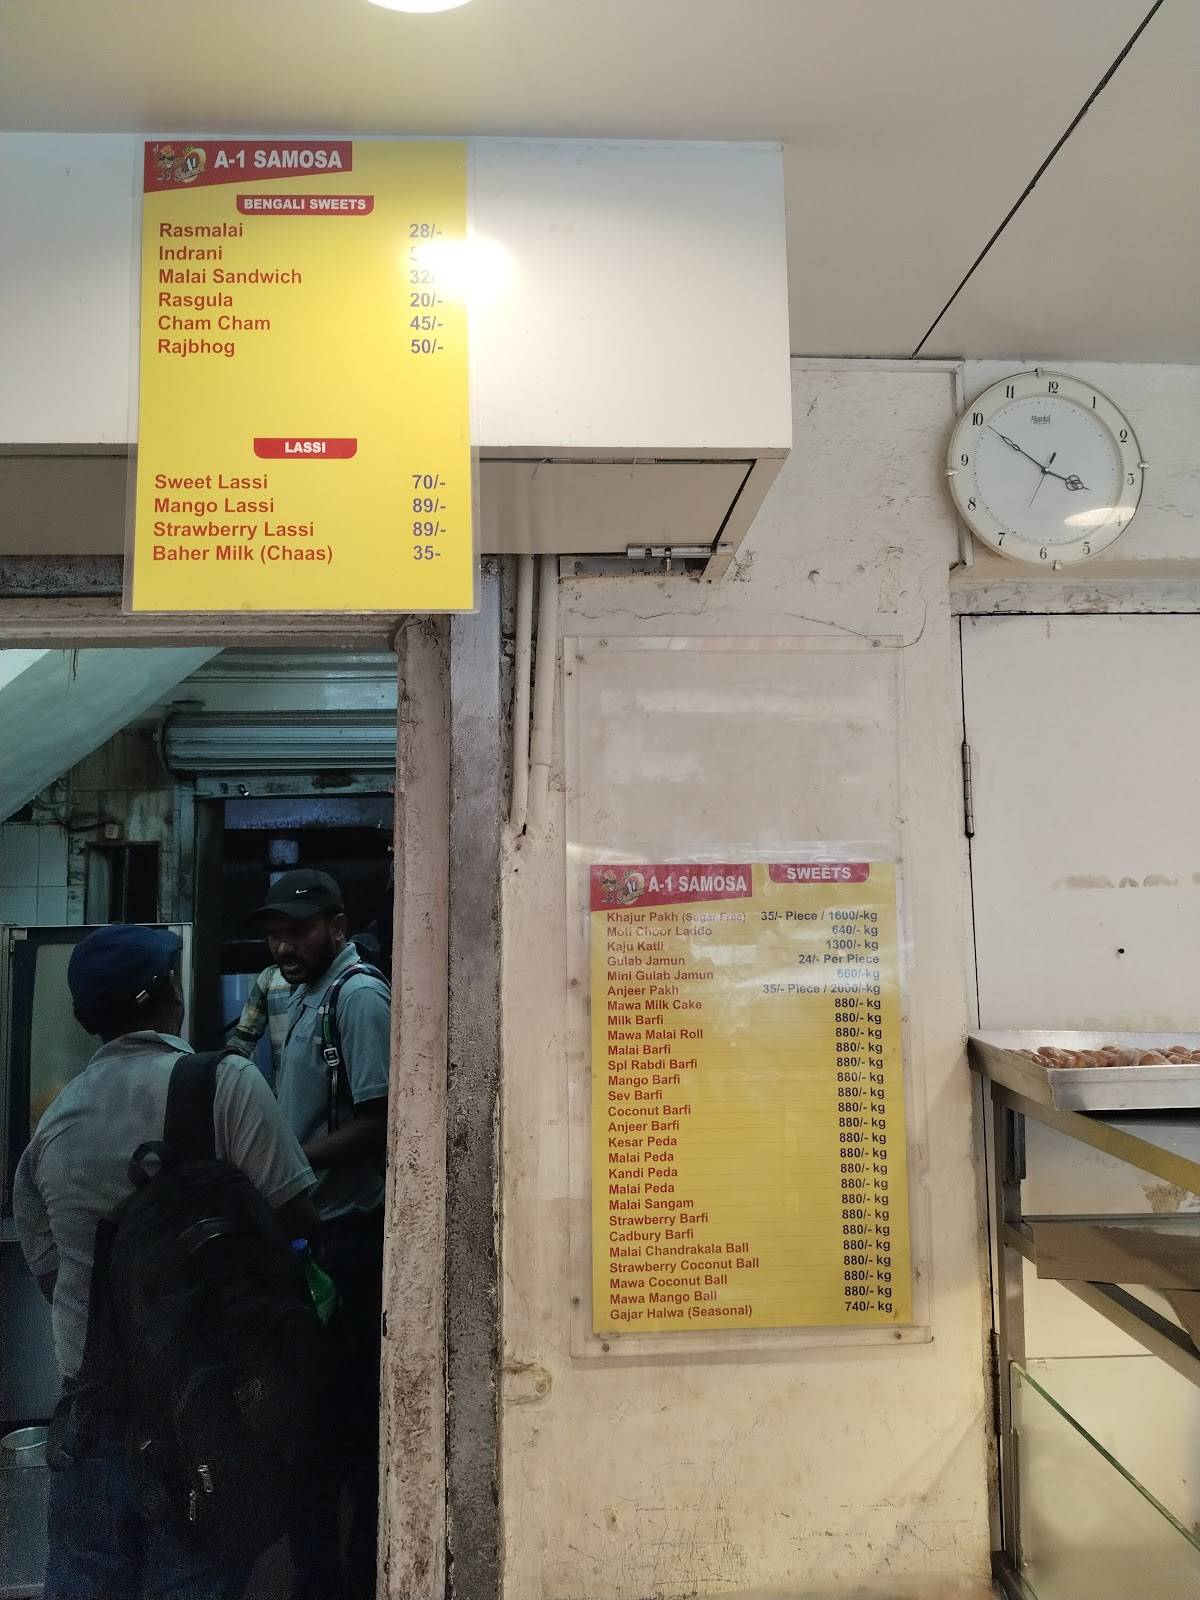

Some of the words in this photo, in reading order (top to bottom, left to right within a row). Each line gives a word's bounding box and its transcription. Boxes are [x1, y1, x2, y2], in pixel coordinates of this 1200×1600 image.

[214, 152, 245, 168] A-1
[254, 151, 342, 168] SAMOSA
[245, 199, 304, 209] BENGALI
[310, 199, 366, 210] SWEETS
[160, 223, 242, 237] Rasmalai
[409, 224, 442, 238] 28/-
[160, 246, 222, 260] Indrani
[160, 269, 205, 283] Malai
[213, 269, 301, 283] Sandwich
[159, 292, 232, 310] Rasgula
[410, 293, 442, 307] 20/-
[159, 316, 210, 330] Cham
[218, 316, 270, 330] Cham
[410, 316, 442, 330] 45/-
[159, 339, 234, 357] Rajbhog
[411, 339, 443, 353] 50/-
[1007, 385, 1014, 398] 11
[1049, 382, 1058, 393] 12
[973, 413, 983, 425] 10
[1120, 430, 1127, 442] 2
[285, 442, 325, 453] LASSI
[962, 455, 968, 465] 9
[155, 474, 211, 489] Sweet
[219, 475, 267, 489] Lassi
[413, 475, 445, 489] 70/-
[155, 498, 217, 516] Mango
[225, 498, 273, 512] Lassi
[413, 498, 445, 512] 89/-
[968, 497, 976, 510] 8
[154, 522, 257, 540] Strawberry
[265, 522, 313, 536] Lassi
[413, 522, 446, 536] 89/-
[999, 533, 1005, 546] 7
[154, 546, 209, 560] Baher
[216, 546, 253, 560] Milk
[261, 545, 332, 564] (Chaas)
[414, 546, 440, 560] 35-
[1040, 548, 1047, 559] 6
[1084, 542, 1090, 554] 5
[787, 868, 851, 879] SWEETS
[649, 878, 672, 891] A-1
[679, 876, 747, 892] SAMOSA
[608, 912, 646, 924] Khajur
[650, 912, 678, 921] Pakh
[761, 912, 782, 920] 35/-
[786, 911, 817, 920] Piece
[829, 911, 877, 922] 1600/-kg
[832, 925, 860, 934] 640/-
[864, 925, 878, 936] kg
[608, 942, 633, 953] Kaju
[638, 942, 663, 951] Katli
[827, 940, 861, 949] 1300/-
[865, 940, 878, 951] kg
[608, 956, 642, 966] Gulab
[646, 956, 685, 965] Jamun
[799, 954, 819, 963] 24/-
[824, 954, 843, 963] Per
[847, 954, 879, 963] Piece
[607, 970, 634, 981] Mini
[637, 971, 670, 980] Gulab
[674, 971, 713, 980] Jamun
[608, 986, 645, 997] Anjeer
[650, 985, 678, 995] Pakh
[608, 1001, 641, 1010] Mawa
[646, 1000, 668, 1009] Milk
[673, 1000, 701, 1009] Cake
[834, 998, 863, 1008] 880/-
[867, 998, 880, 1009] kg
[608, 1016, 631, 1025] Milk
[636, 1015, 663, 1024] Barfi
[835, 1013, 864, 1023] 880/-
[868, 1013, 881, 1024] kg
[608, 1031, 641, 1040] Mawa
[646, 1030, 675, 1039] Malai
[681, 1029, 702, 1039] Roll
[836, 1027, 864, 1038] 880/-
[868, 1028, 881, 1039] kg
[609, 1046, 638, 1055] Malai
[644, 1045, 670, 1054] Barfi
[836, 1042, 865, 1052] 880/-
[869, 1042, 882, 1054] kg
[609, 1060, 626, 1072] Spl
[632, 1060, 665, 1069] Rabdi
[670, 1059, 697, 1069] Barfi
[836, 1057, 865, 1067] 880/-
[609, 1076, 648, 1087] Mango
[653, 1074, 679, 1084] Barfi
[837, 1072, 866, 1082] 880/-
[870, 1072, 883, 1084] kg
[609, 1091, 630, 1100] Sev
[635, 1090, 662, 1100] Barfi
[838, 1087, 867, 1097] 880/-
[608, 1106, 658, 1116] Coconut
[663, 1105, 690, 1115] Barfi
[838, 1102, 867, 1112] 880/-
[871, 1103, 884, 1114] kg
[608, 1122, 647, 1134] Anjeer
[652, 1120, 679, 1130] Barfi
[839, 1117, 868, 1127] 880/-
[872, 1118, 885, 1129] kg
[609, 1138, 643, 1147] Kesar
[648, 1136, 676, 1146] Peda
[839, 1133, 868, 1143] 880/-
[609, 1153, 639, 1163] Malai
[645, 1152, 673, 1162] Peda
[840, 1148, 869, 1158] 880/-
[873, 1148, 886, 1159] kg
[609, 1168, 643, 1178] Kandi
[648, 1167, 677, 1177] Peda
[840, 1163, 870, 1173] 880/-
[610, 1184, 640, 1194] Malai
[645, 1183, 674, 1193] Peda
[841, 1178, 870, 1189] 880/-
[874, 1179, 888, 1190] kg
[610, 1200, 640, 1210] Malai
[645, 1199, 693, 1210] Sangam
[841, 1194, 871, 1204] 880/-
[610, 1215, 675, 1227] Strawberry
[680, 1213, 707, 1223] Barfi
[842, 1209, 871, 1219] 880/-
[875, 1209, 889, 1221] kg
[610, 1231, 661, 1242] Cadbury
[666, 1229, 693, 1239] Barfi
[842, 1225, 872, 1235] 880/-
[610, 1247, 641, 1257] Malai
[646, 1244, 721, 1256] Chandrakala
[727, 1243, 748, 1253] Ball
[843, 1240, 872, 1250] 880/-
[876, 1240, 890, 1251] kg
[610, 1261, 676, 1274] Strawberry
[681, 1260, 732, 1270] Coconut
[737, 1258, 758, 1268] Ball
[844, 1255, 873, 1266] 880/-
[877, 1255, 890, 1267] kg
[611, 1279, 644, 1288] Mawa
[649, 1276, 700, 1287] Coconut
[705, 1275, 727, 1284] Ball
[844, 1270, 874, 1281] 880/-
[877, 1271, 891, 1282] kg
[611, 1294, 644, 1304] Mawa
[649, 1293, 689, 1304] Mango
[695, 1291, 716, 1301] Ball
[845, 1285, 874, 1296] 880/-
[878, 1286, 891, 1297] kg
[610, 1309, 643, 1321] Gajar
[648, 1308, 683, 1318] Halwa
[688, 1305, 752, 1319] (Seasonal)
[845, 1301, 874, 1311] 740/-
[878, 1301, 892, 1313] kg
